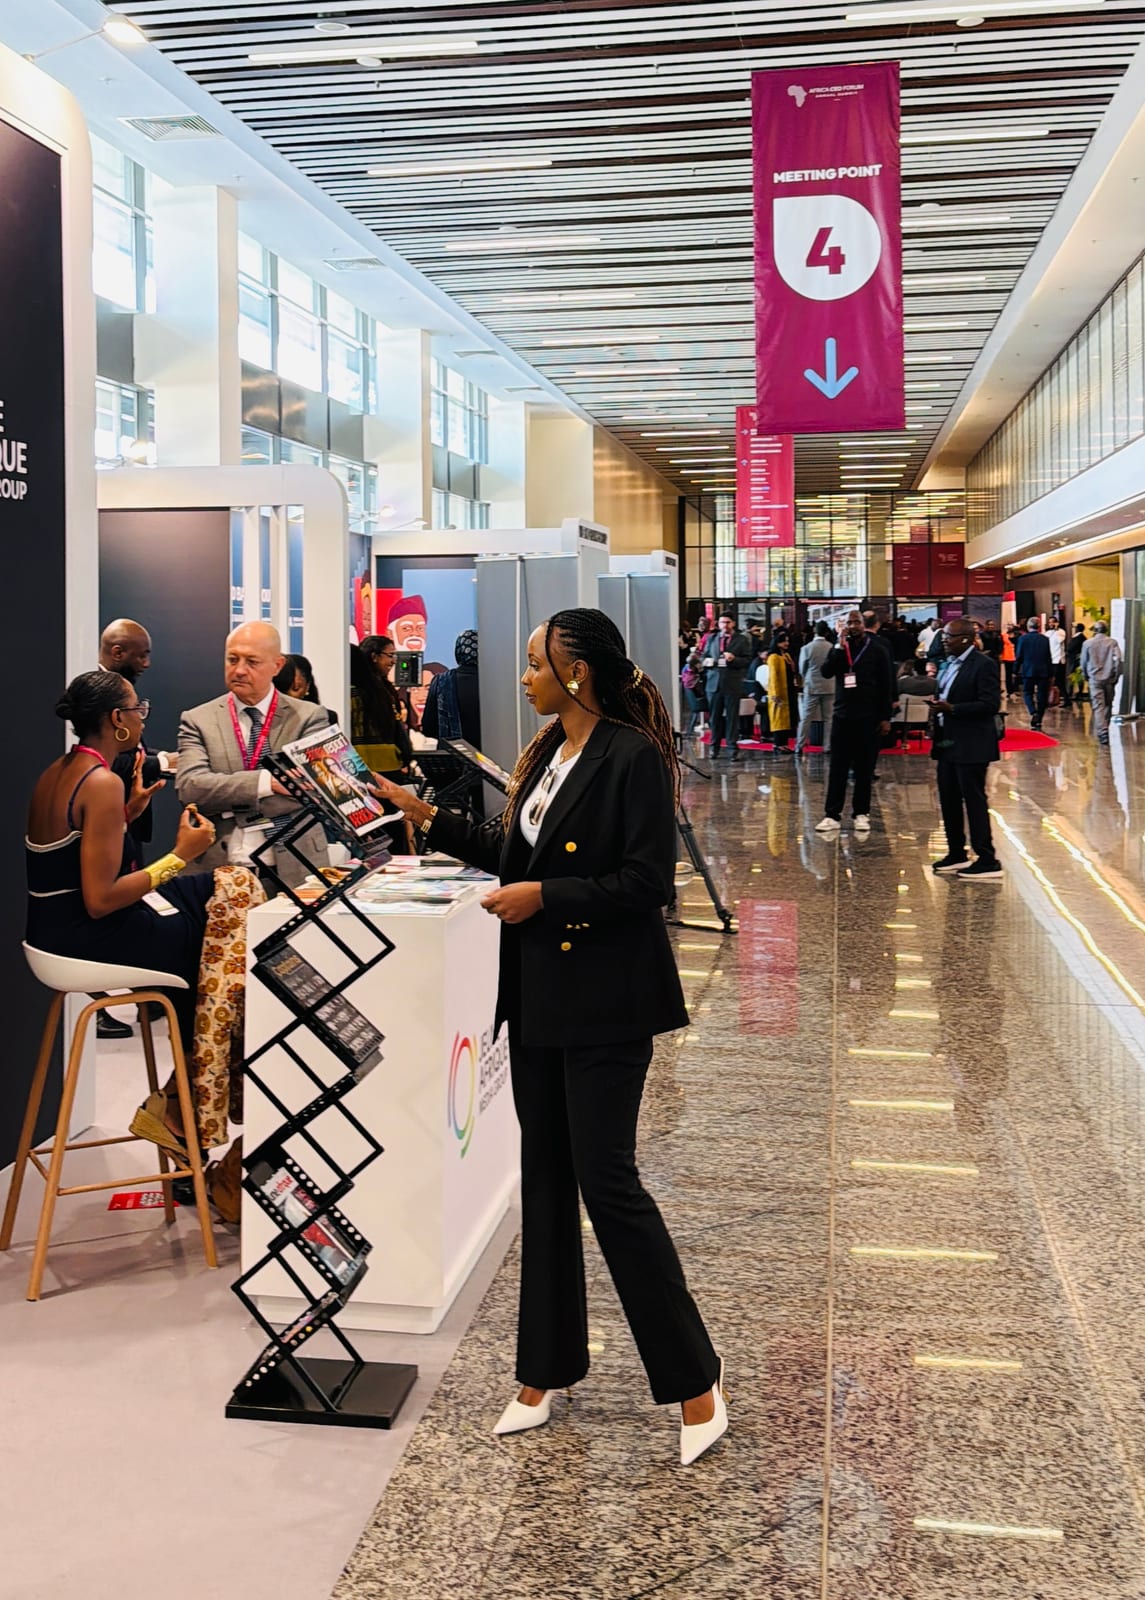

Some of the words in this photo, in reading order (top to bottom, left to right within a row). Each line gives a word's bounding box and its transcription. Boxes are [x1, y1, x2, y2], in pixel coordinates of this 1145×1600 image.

[773, 167, 837, 184] MEETING
[838, 163, 883, 180] POINT
[805, 226, 846, 275] 4
